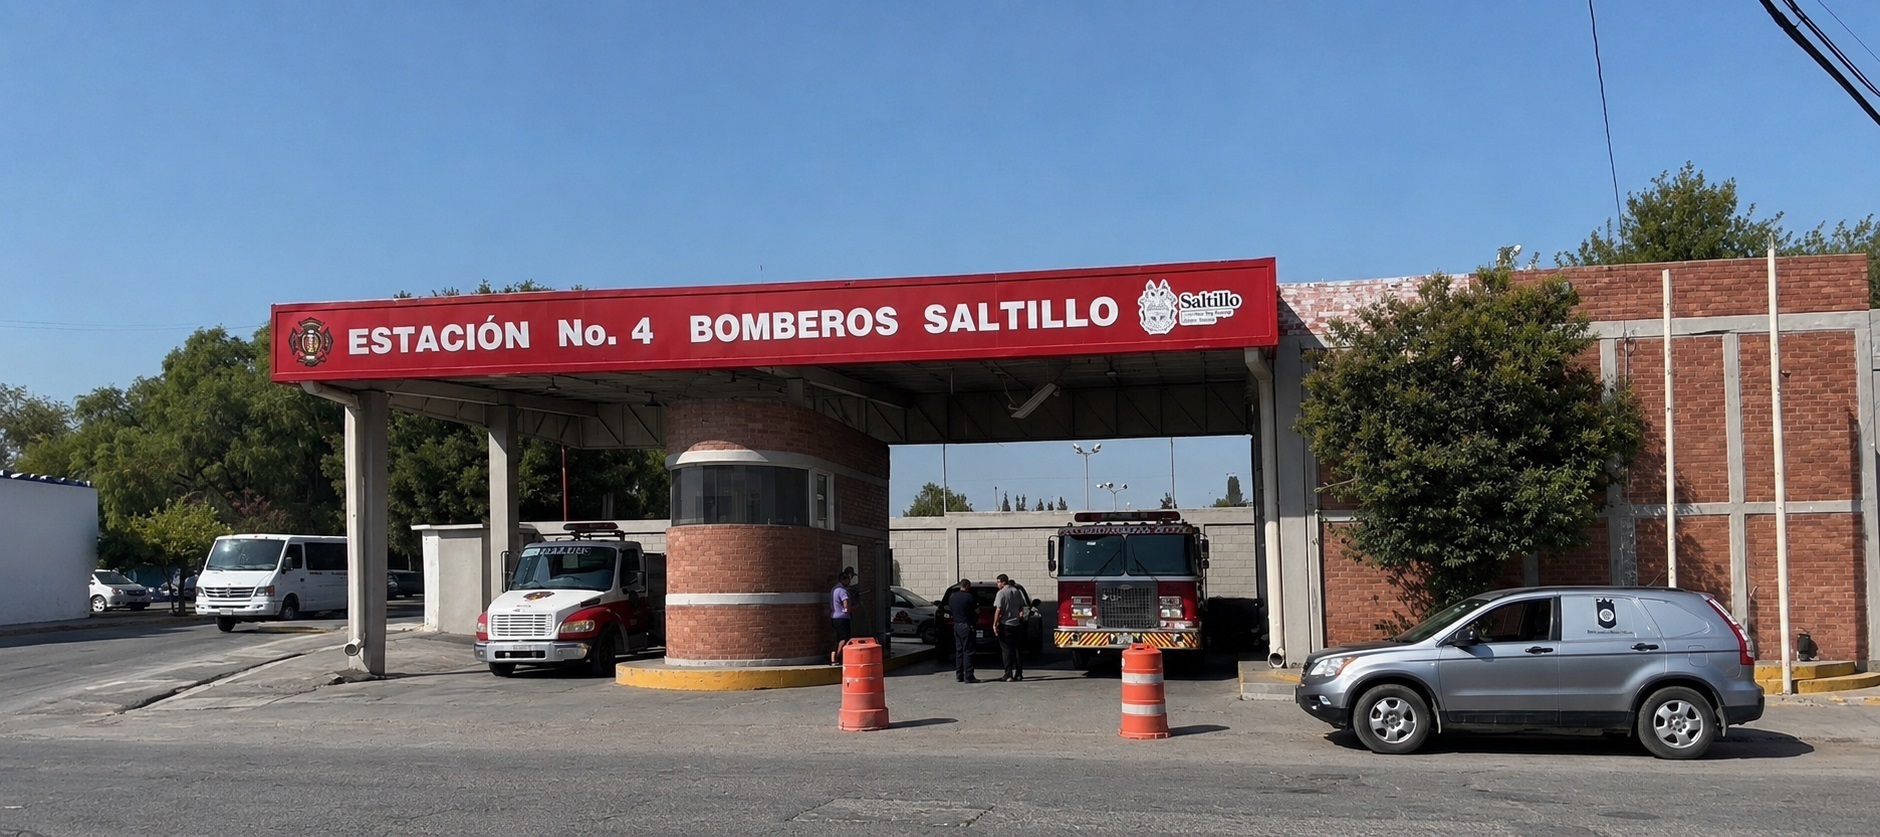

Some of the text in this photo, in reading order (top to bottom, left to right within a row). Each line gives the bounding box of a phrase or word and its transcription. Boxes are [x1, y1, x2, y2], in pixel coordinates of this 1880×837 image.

[1180, 292, 1240, 309] Saltillo
[348, 296, 1119, 355] ESTACIÓN No. 4 BOMBEROS SALTILLO
